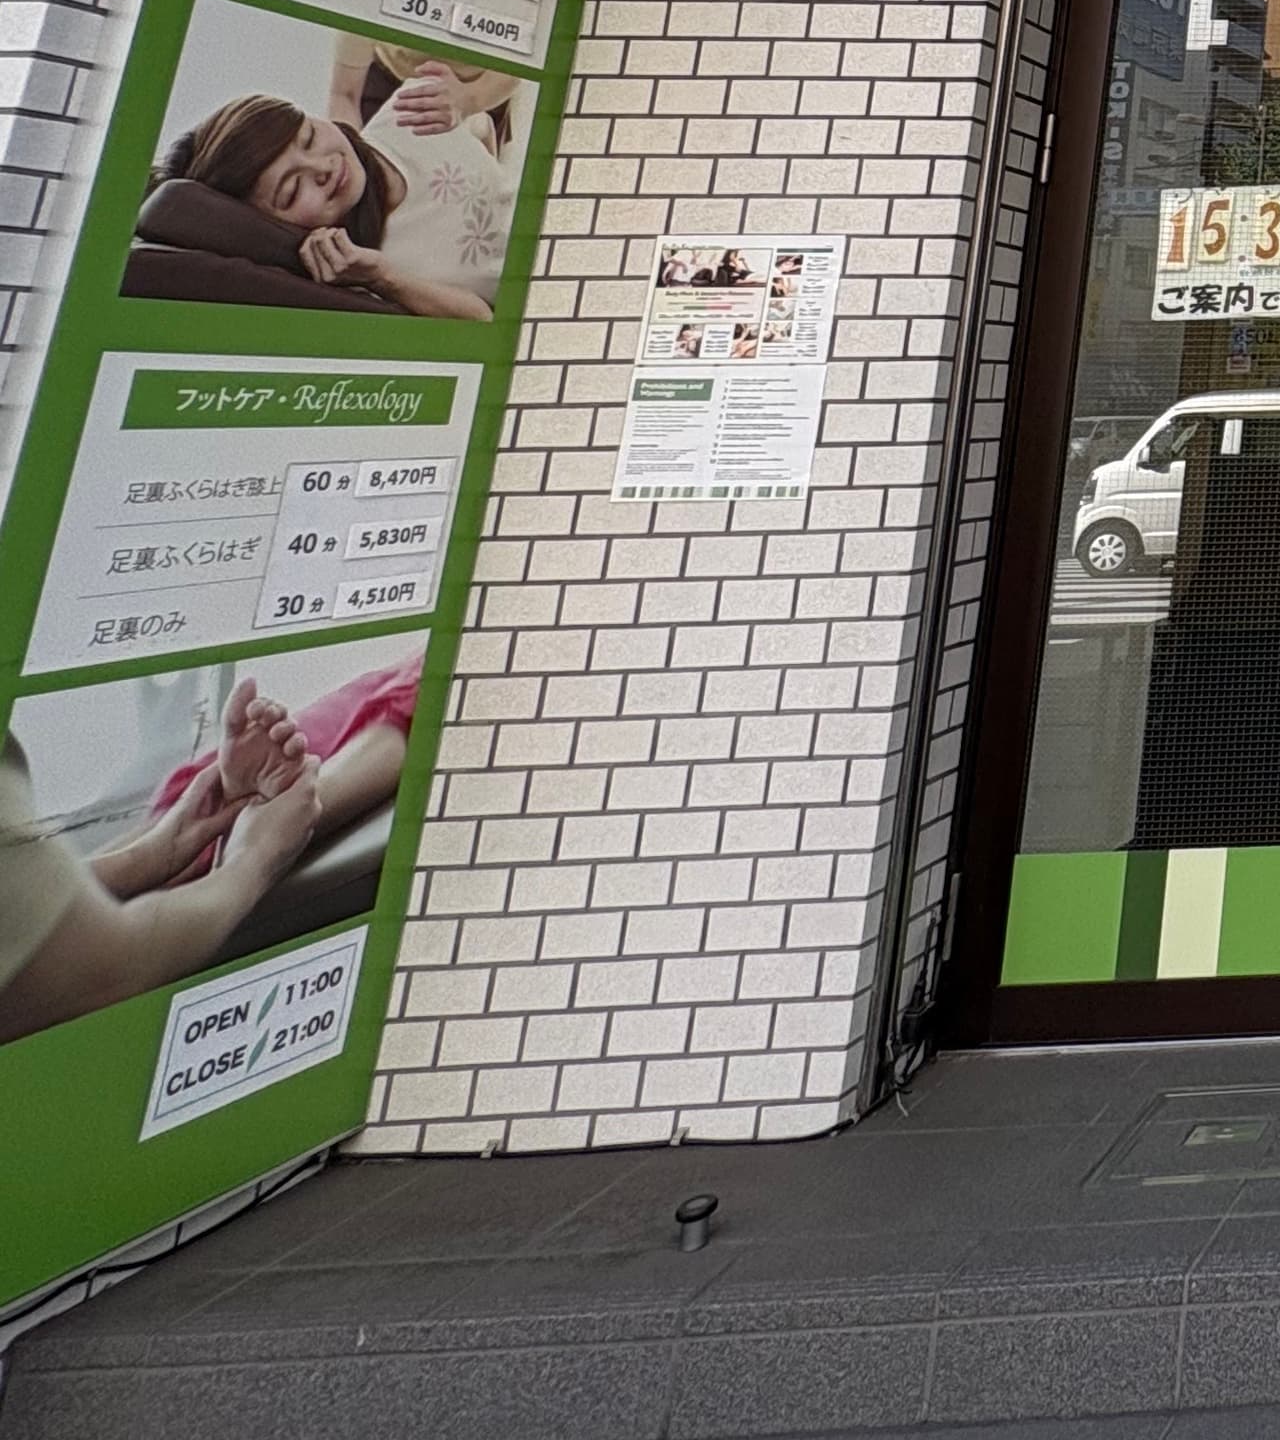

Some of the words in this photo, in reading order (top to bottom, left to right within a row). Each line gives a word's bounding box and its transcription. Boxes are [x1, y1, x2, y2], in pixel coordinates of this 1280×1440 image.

[463, 14, 520, 42] 4,400円
[370, 466, 437, 488] 8,470円
[106, 537, 262, 576] 足裏ふくらはぎ
[359, 525, 427, 548] 5,830円
[88, 611, 187, 647] 足裏のみ
[347, 583, 415, 608] 4,510円
[184, 1000, 250, 1045] OPEN
[284, 965, 343, 1006] 11:00
[165, 1044, 247, 1097] CLOSE
[272, 1010, 335, 1053] 21:00
